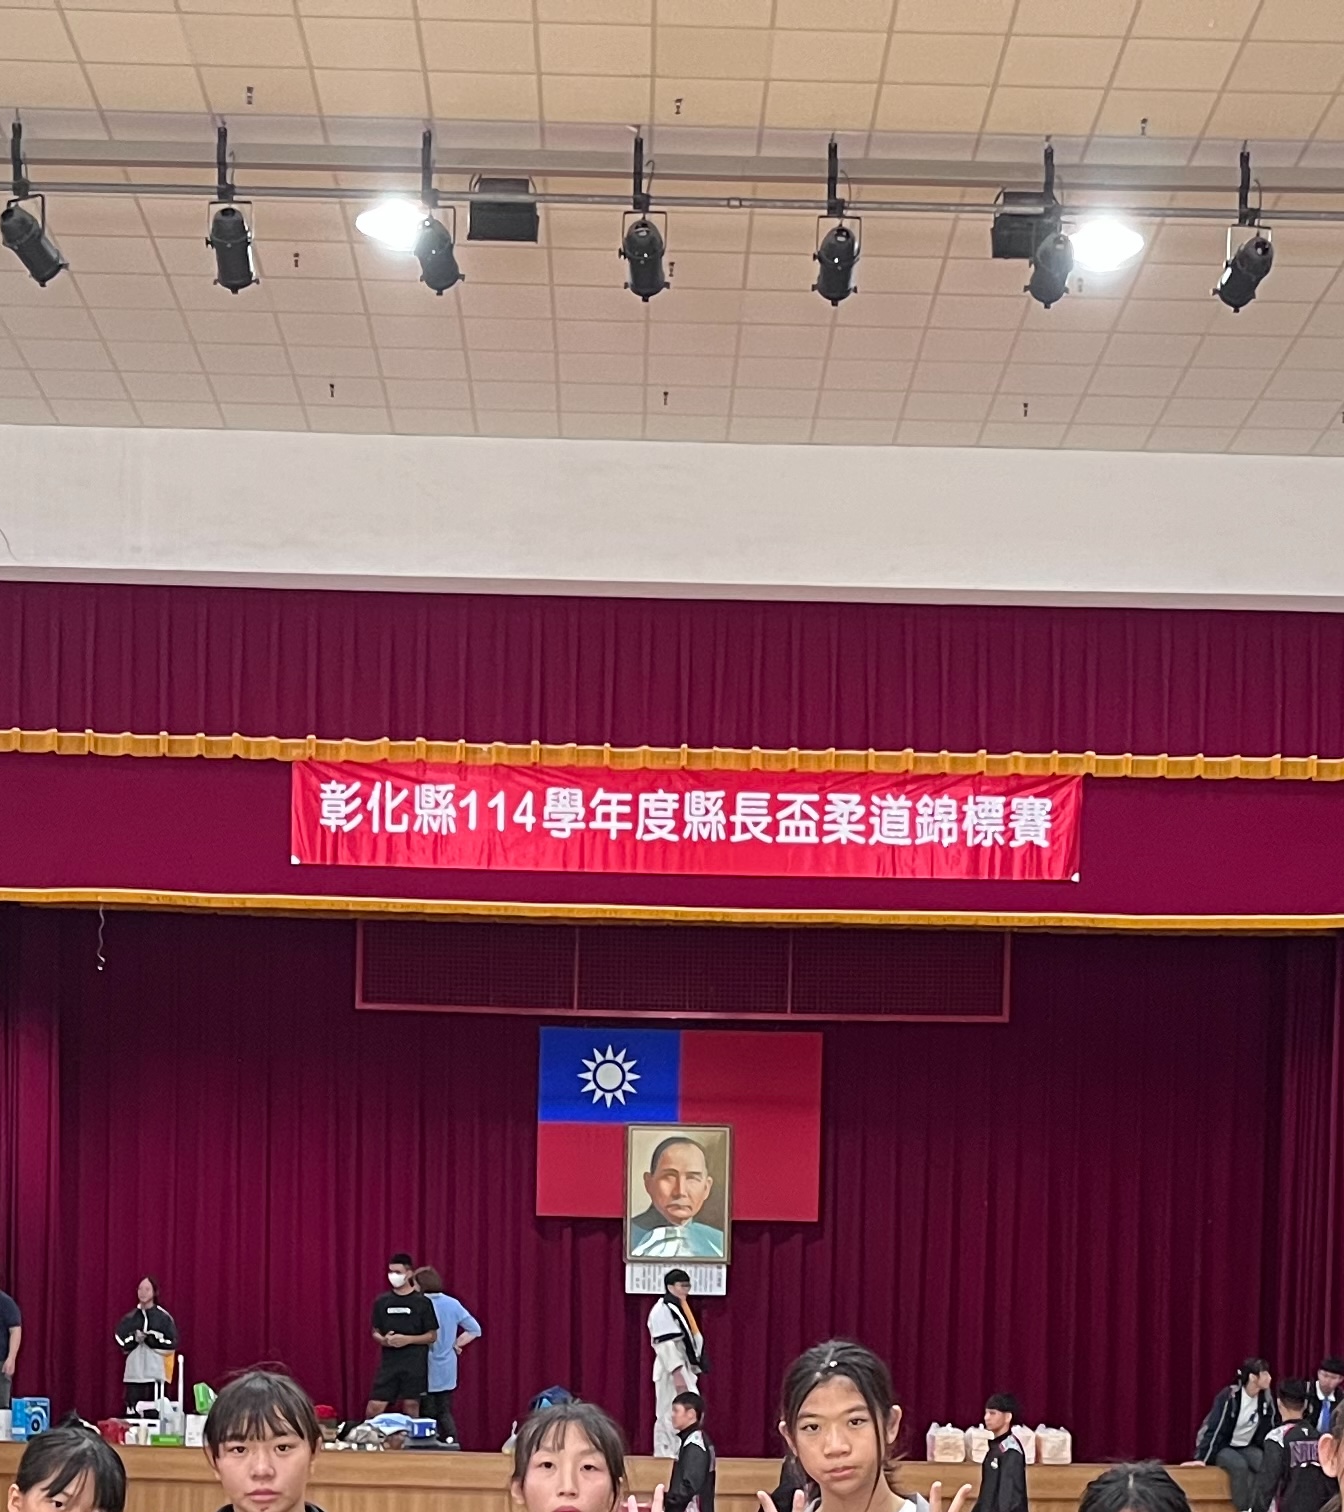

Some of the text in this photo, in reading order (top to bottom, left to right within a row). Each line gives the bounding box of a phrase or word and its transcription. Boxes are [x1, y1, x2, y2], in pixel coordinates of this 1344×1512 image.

[318, 779, 1055, 850] 彰化縣114學年度縣長盃柔道錦標賽
